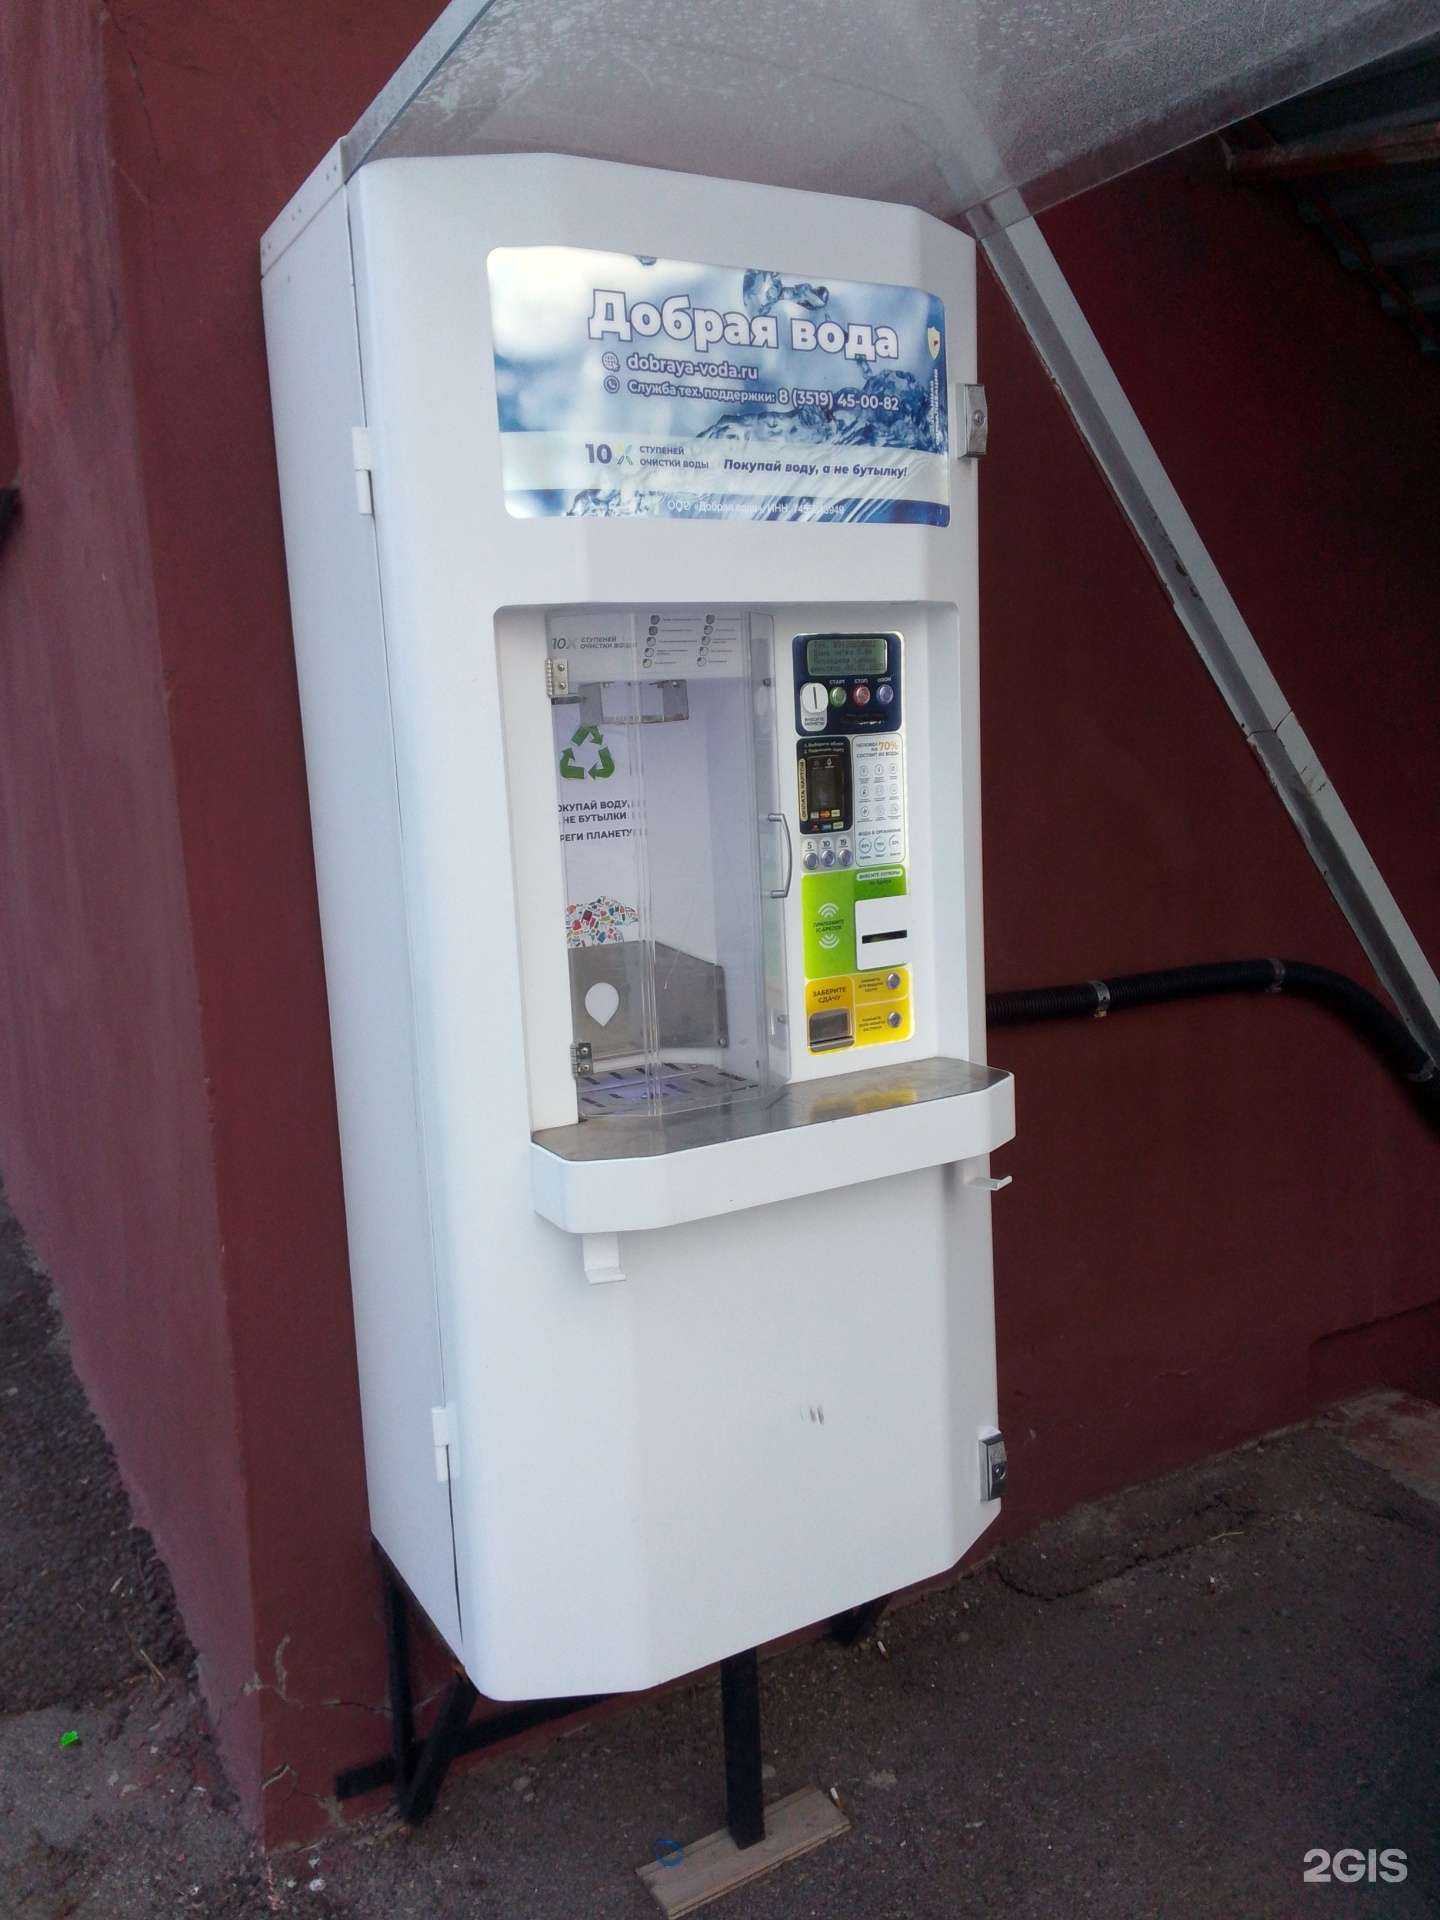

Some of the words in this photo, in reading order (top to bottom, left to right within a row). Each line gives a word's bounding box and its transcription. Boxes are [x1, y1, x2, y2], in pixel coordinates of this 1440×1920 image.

[588, 289, 778, 352] Добрая
[791, 318, 898, 361] вода
[627, 352, 758, 380] dobraya-voda.ru
[628, 379, 679, 397] Служба
[704, 388, 776, 404] поддержки:
[778, 388, 789, 404] 8
[793, 388, 833, 410] (3519)
[837, 393, 899, 411] 45-00-82
[585, 443, 613, 464] 10
[640, 445, 685, 455] СТУПЕНЕЙ
[640, 458, 681, 467] ОЧИСТКИ
[683, 459, 709, 469] ВОДЫ
[723, 459, 781, 474] Покупай
[785, 463, 819, 475] воду,
[822, 466, 831, 474] а
[834, 465, 849, 474] не
[853, 464, 908, 479] бутылку!
[553, 638, 567, 650] 10
[558, 800, 598, 813] ОКУПАЙ
[563, 815, 576, 824] НЕ
[578, 812, 627, 823] БУТЫЛКИ
[560, 833, 584, 842] РЕГИ
[586, 828, 632, 840] ПЛАНЕТУ
[807, 842, 813, 850] 5
[822, 840, 831, 848] 10
